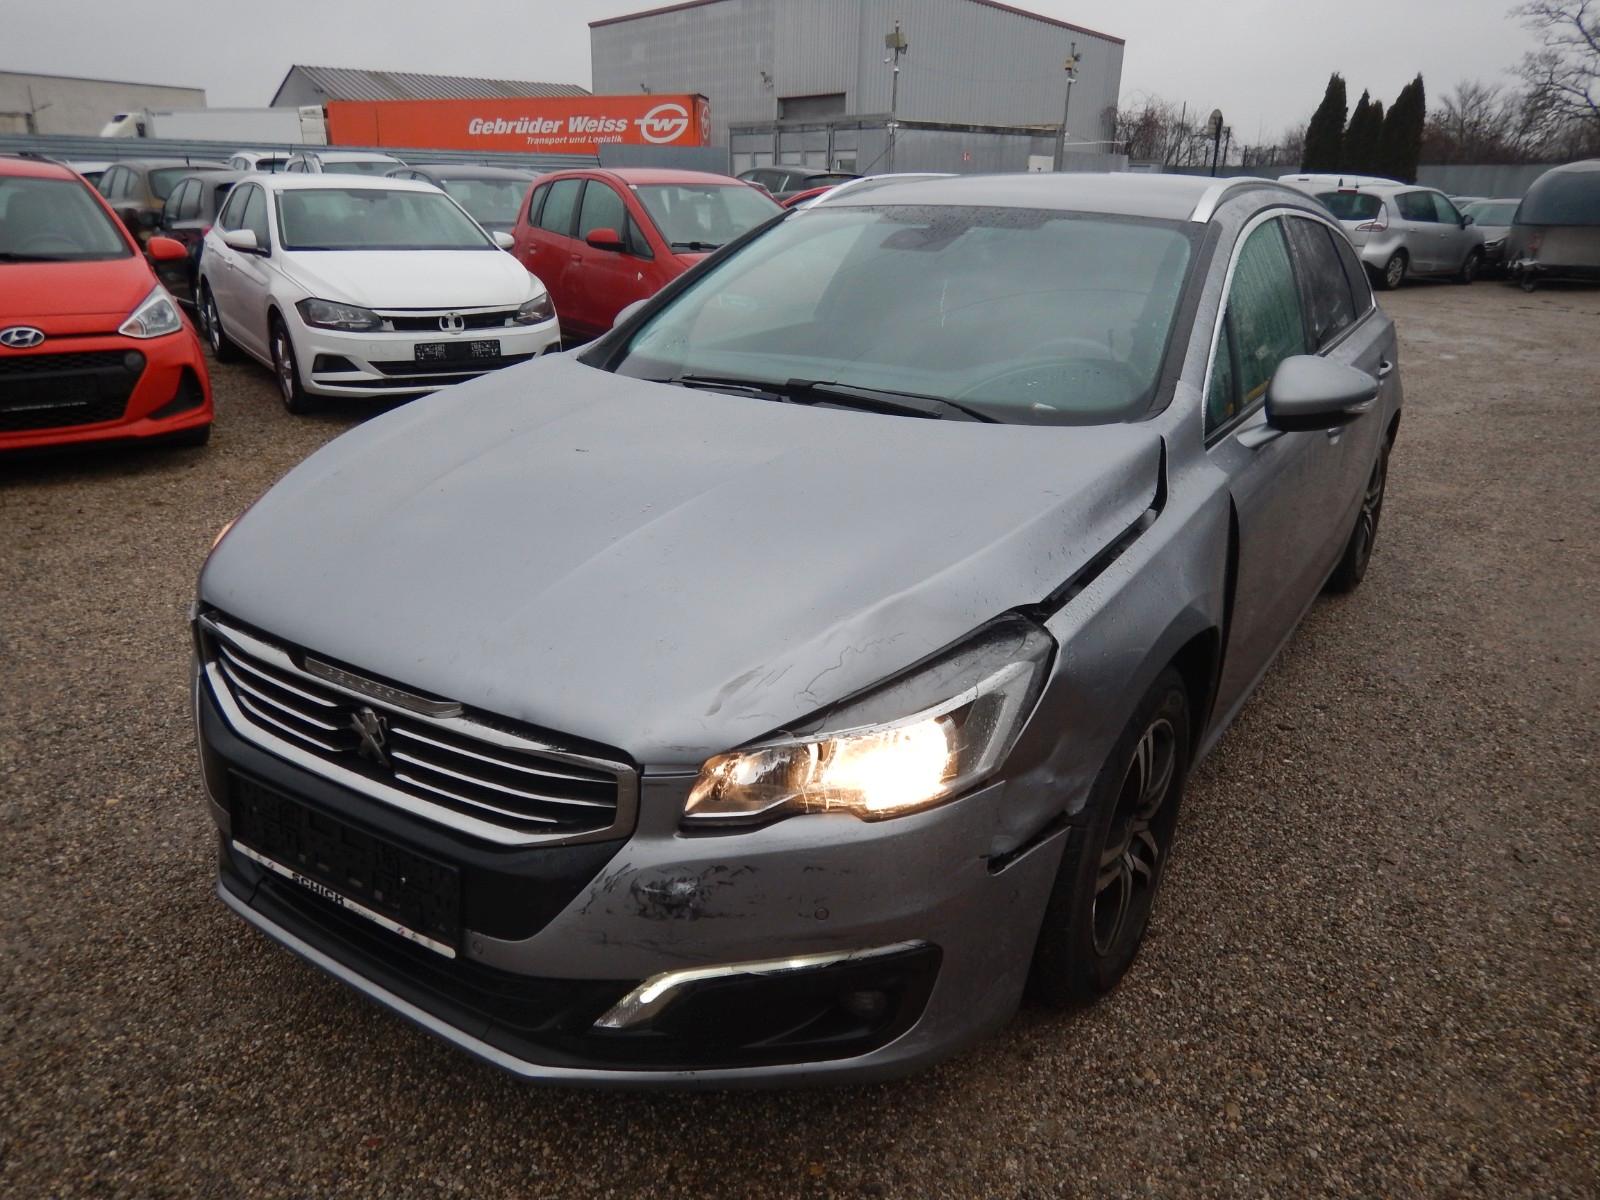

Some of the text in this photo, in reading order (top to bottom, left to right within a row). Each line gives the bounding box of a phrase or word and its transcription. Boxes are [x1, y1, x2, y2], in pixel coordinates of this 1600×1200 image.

[468, 115, 628, 135] Gebrüder Weiss
[526, 135, 623, 146] Transport und Logistik
